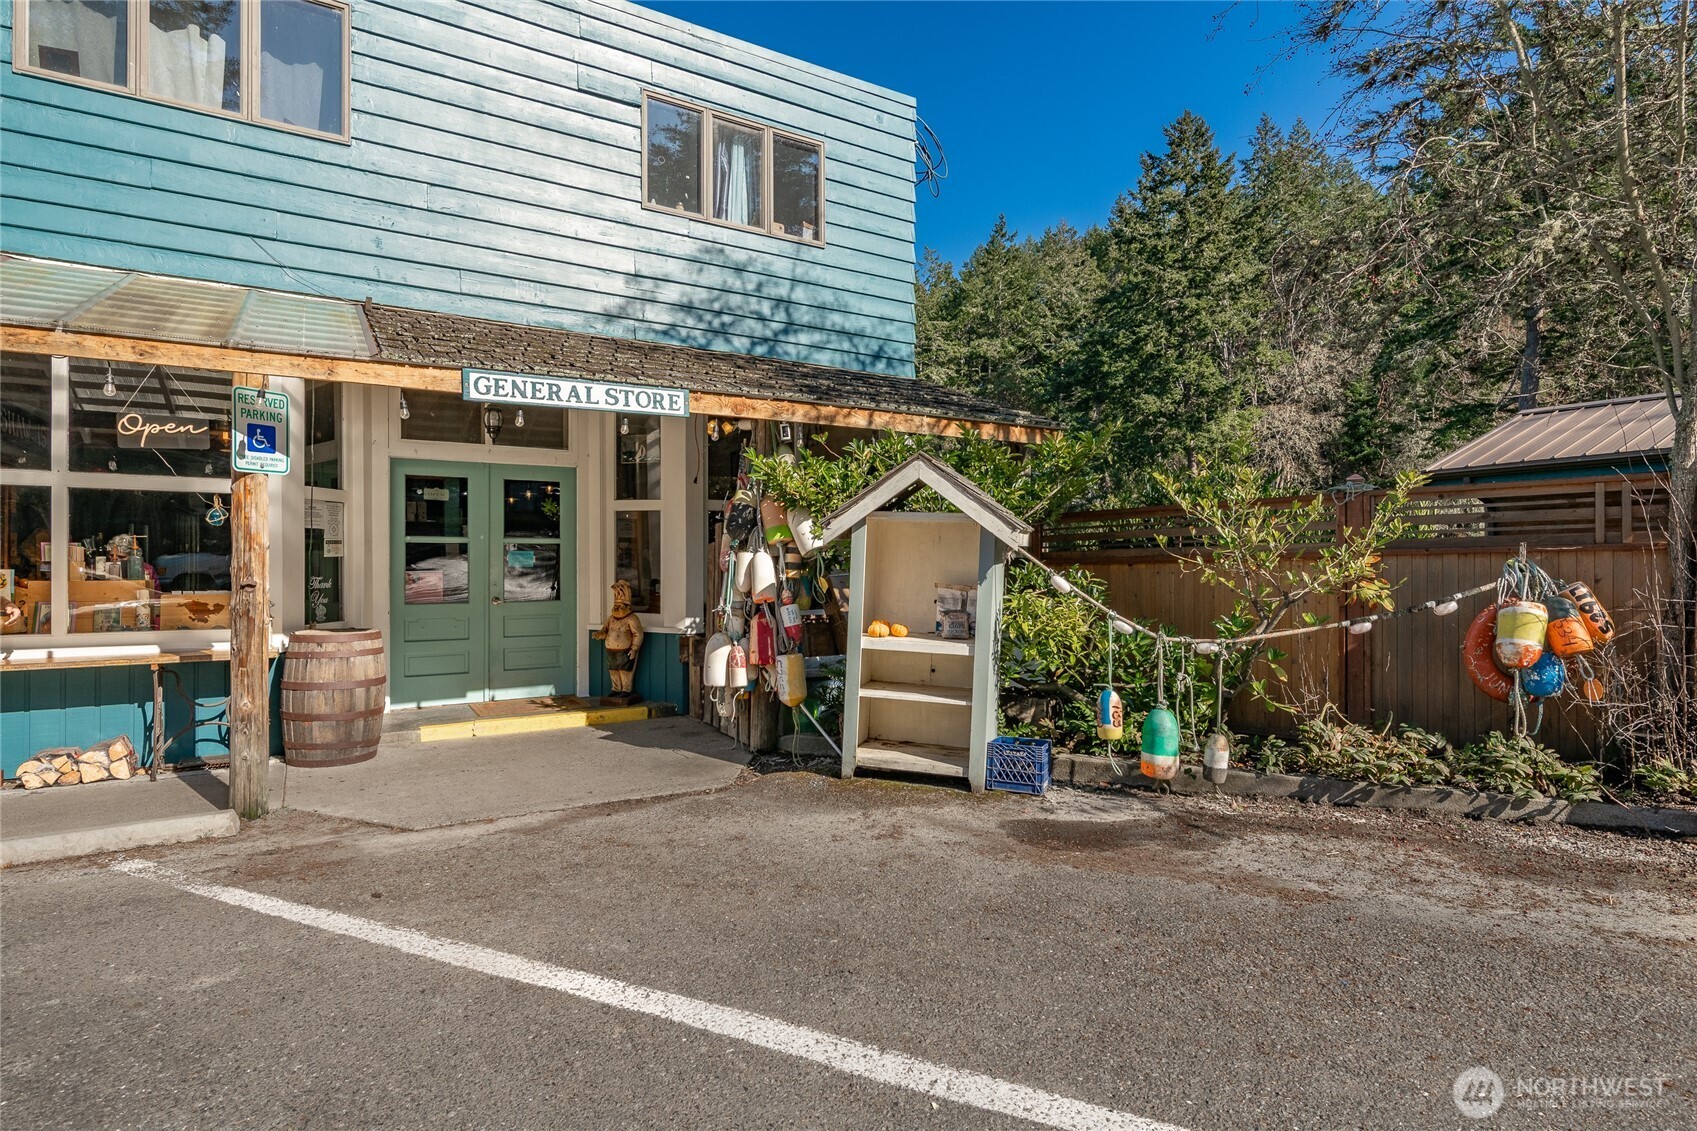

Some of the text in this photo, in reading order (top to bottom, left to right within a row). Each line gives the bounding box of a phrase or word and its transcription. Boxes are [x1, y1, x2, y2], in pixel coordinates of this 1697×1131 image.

[237, 393, 285, 410] RESRVED
[473, 375, 682, 412] GENERAL STORE
[240, 407, 283, 424] PARKING
[117, 413, 209, 448] Open
[308, 576, 333, 590] Thank
